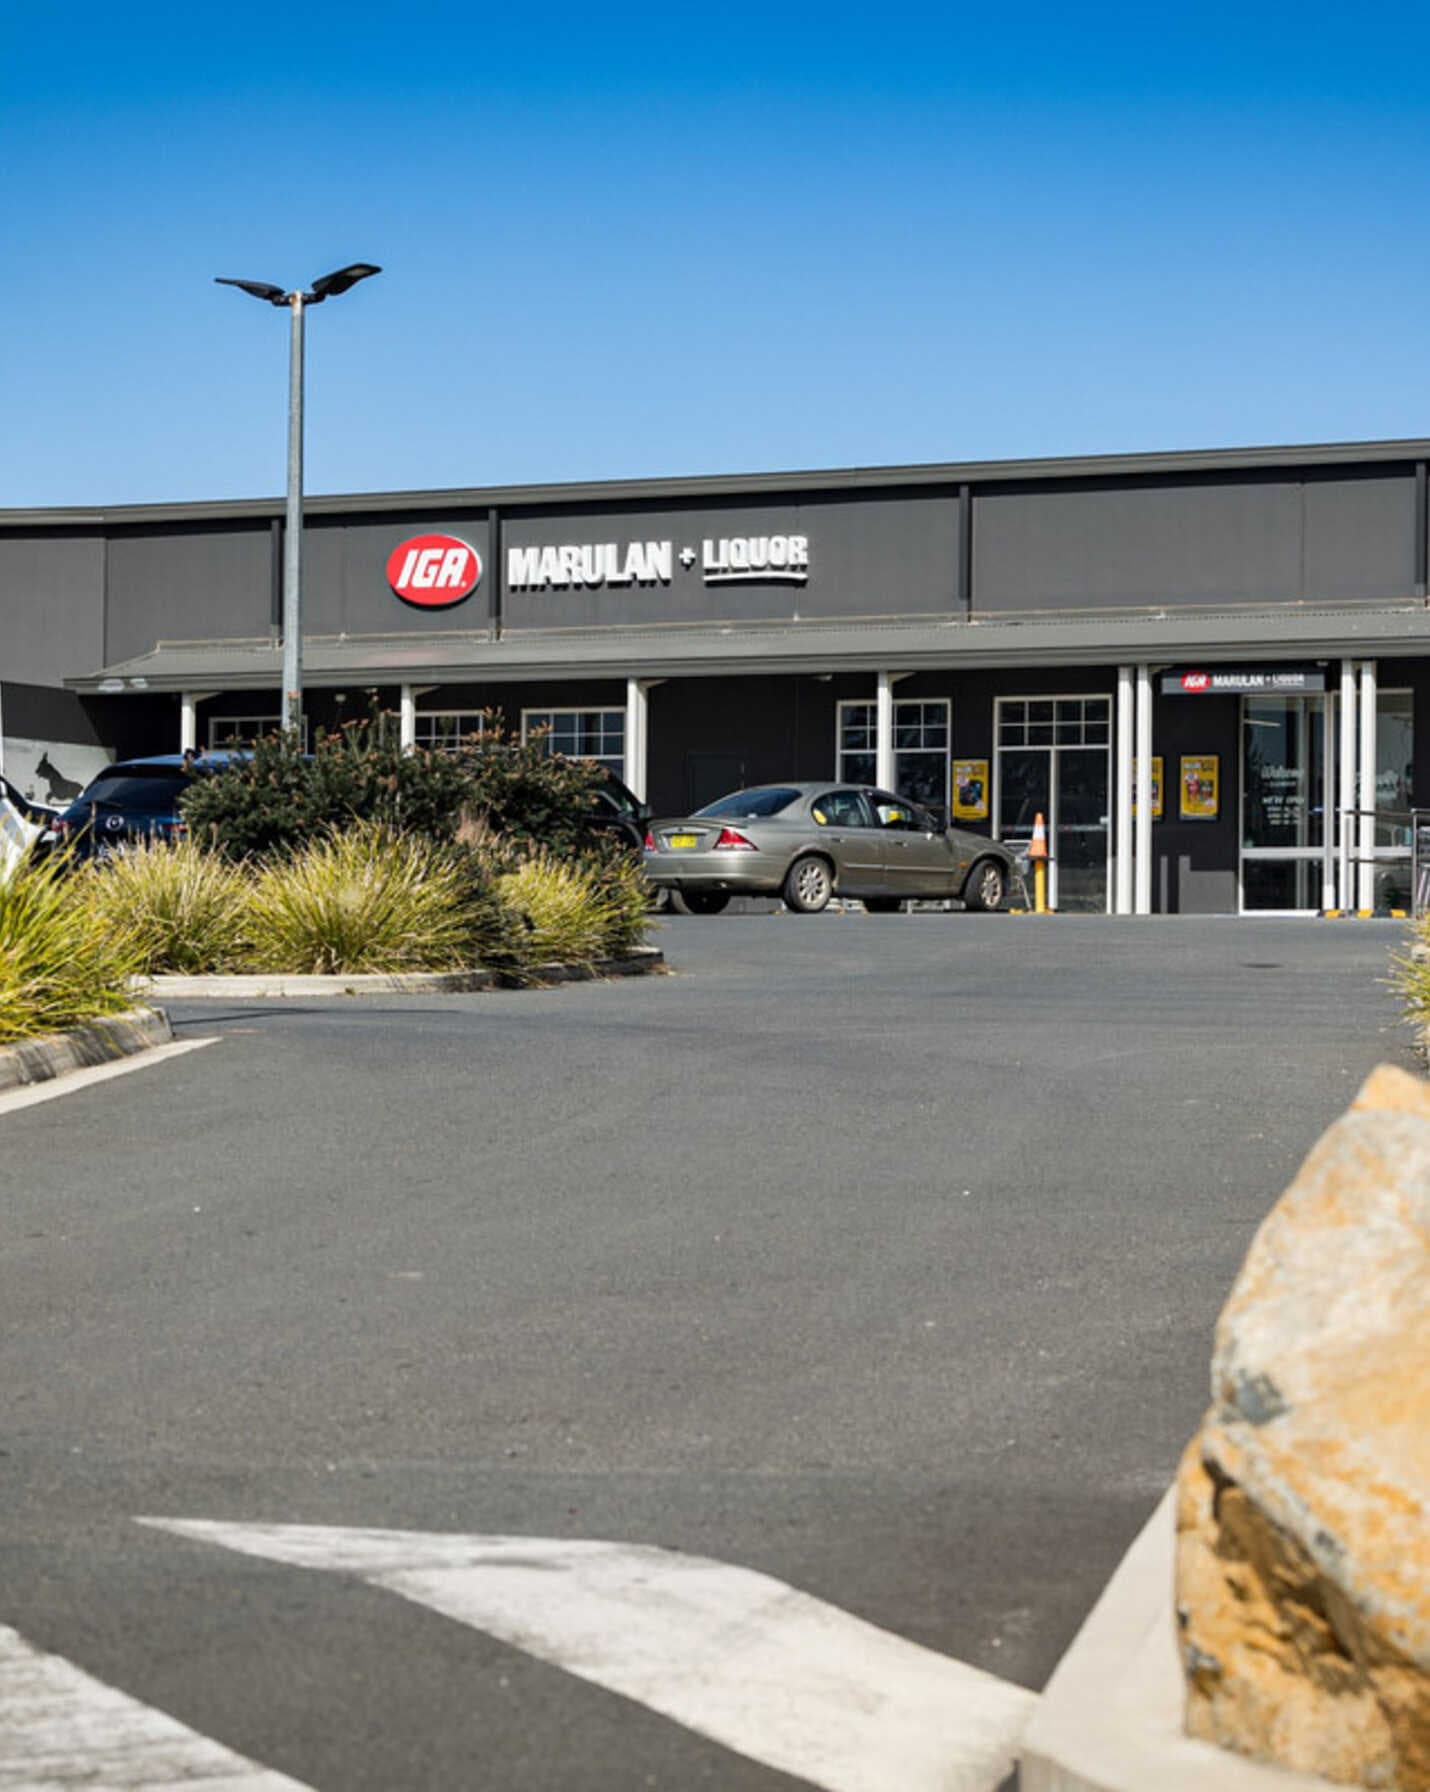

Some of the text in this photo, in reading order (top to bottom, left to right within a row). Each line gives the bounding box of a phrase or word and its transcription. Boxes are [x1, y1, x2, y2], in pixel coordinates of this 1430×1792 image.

[396, 548, 468, 588] IGA
[508, 536, 809, 586] MARULAN + LIQUOR
[1212, 674, 1265, 687] MARULAN
